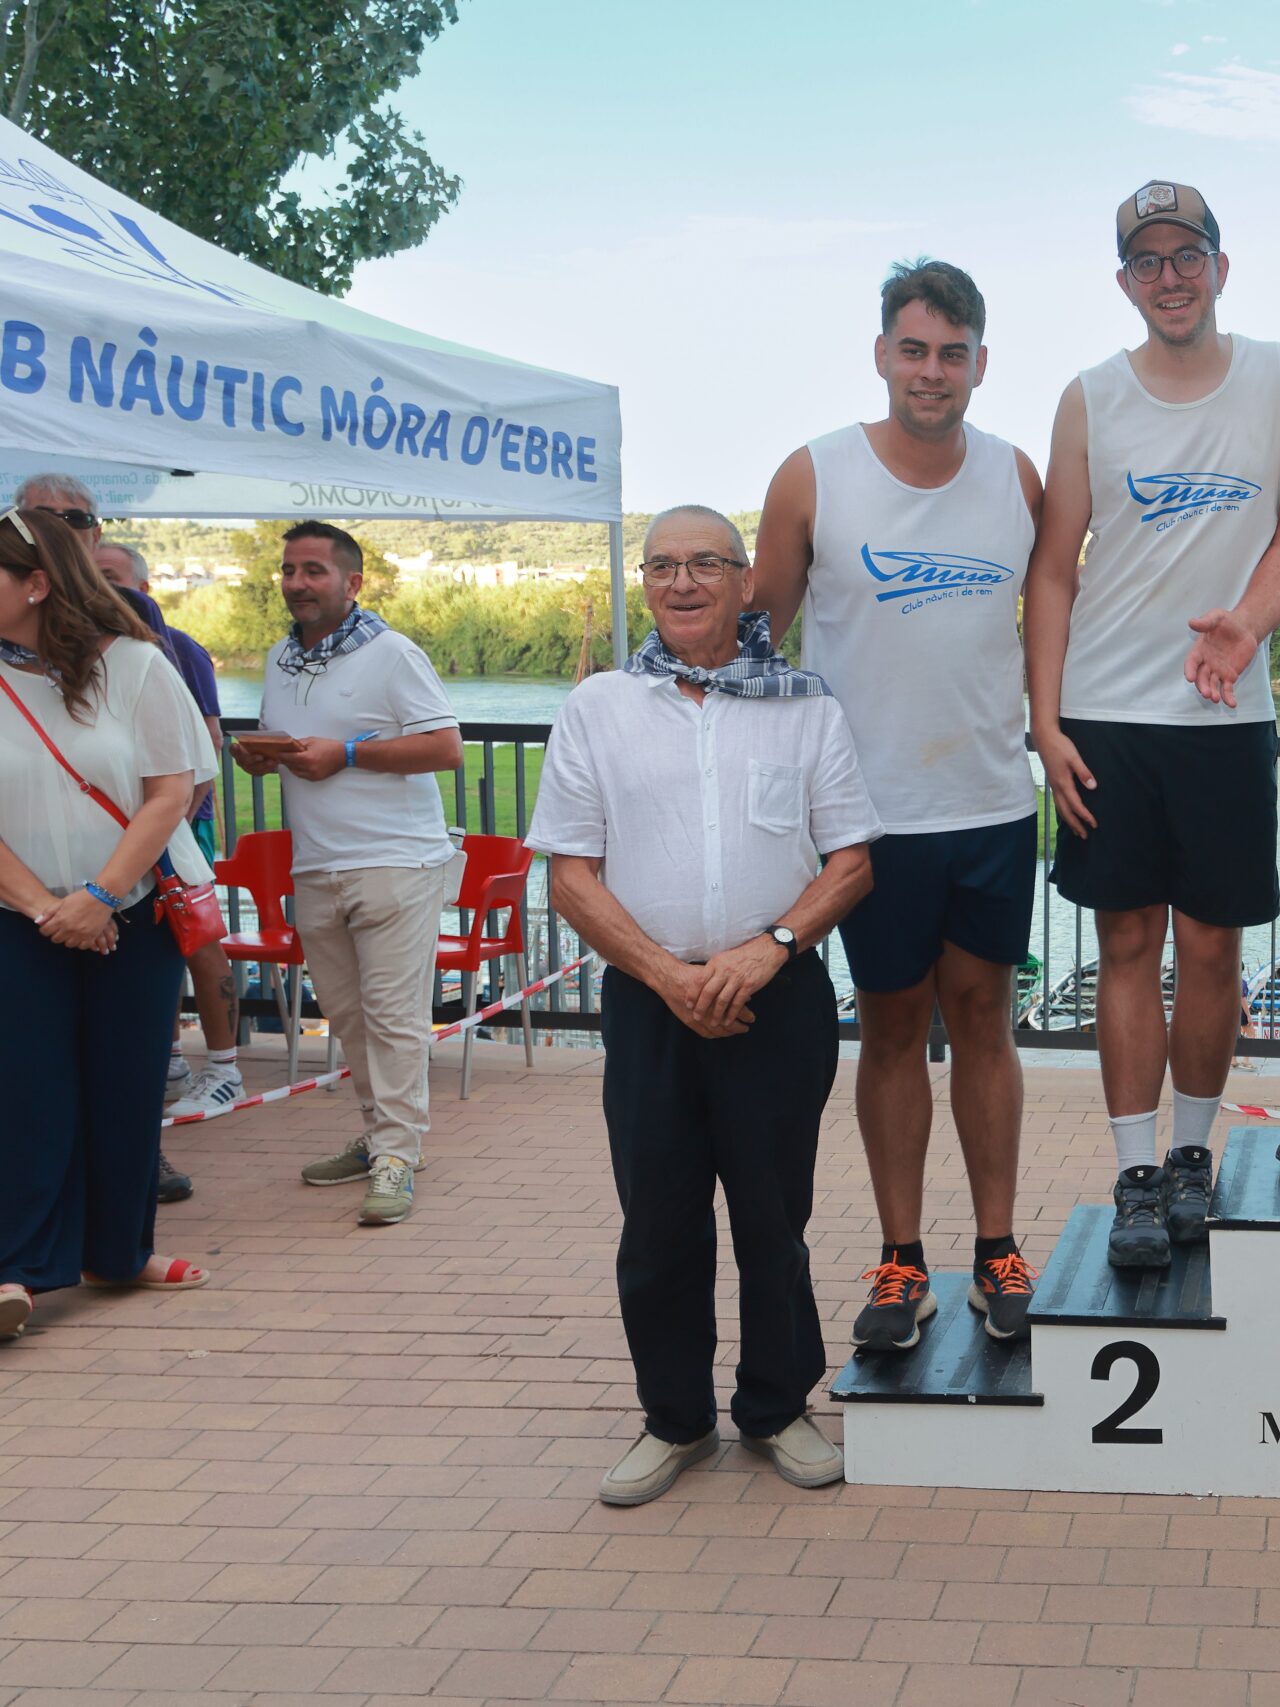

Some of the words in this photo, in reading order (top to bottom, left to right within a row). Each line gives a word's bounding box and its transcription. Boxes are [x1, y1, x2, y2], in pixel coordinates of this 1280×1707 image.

[69, 326, 305, 437] NÀUTIC
[320, 376, 450, 461] MÓRA
[1156, 518, 1176, 532] Club
[1211, 503, 1222, 512] de
[1223, 504, 1240, 512] rem
[902, 600, 923, 615] Club
[961, 586, 973, 596] de
[976, 588, 993, 596] rem
[1090, 1340, 1163, 1444] 2
